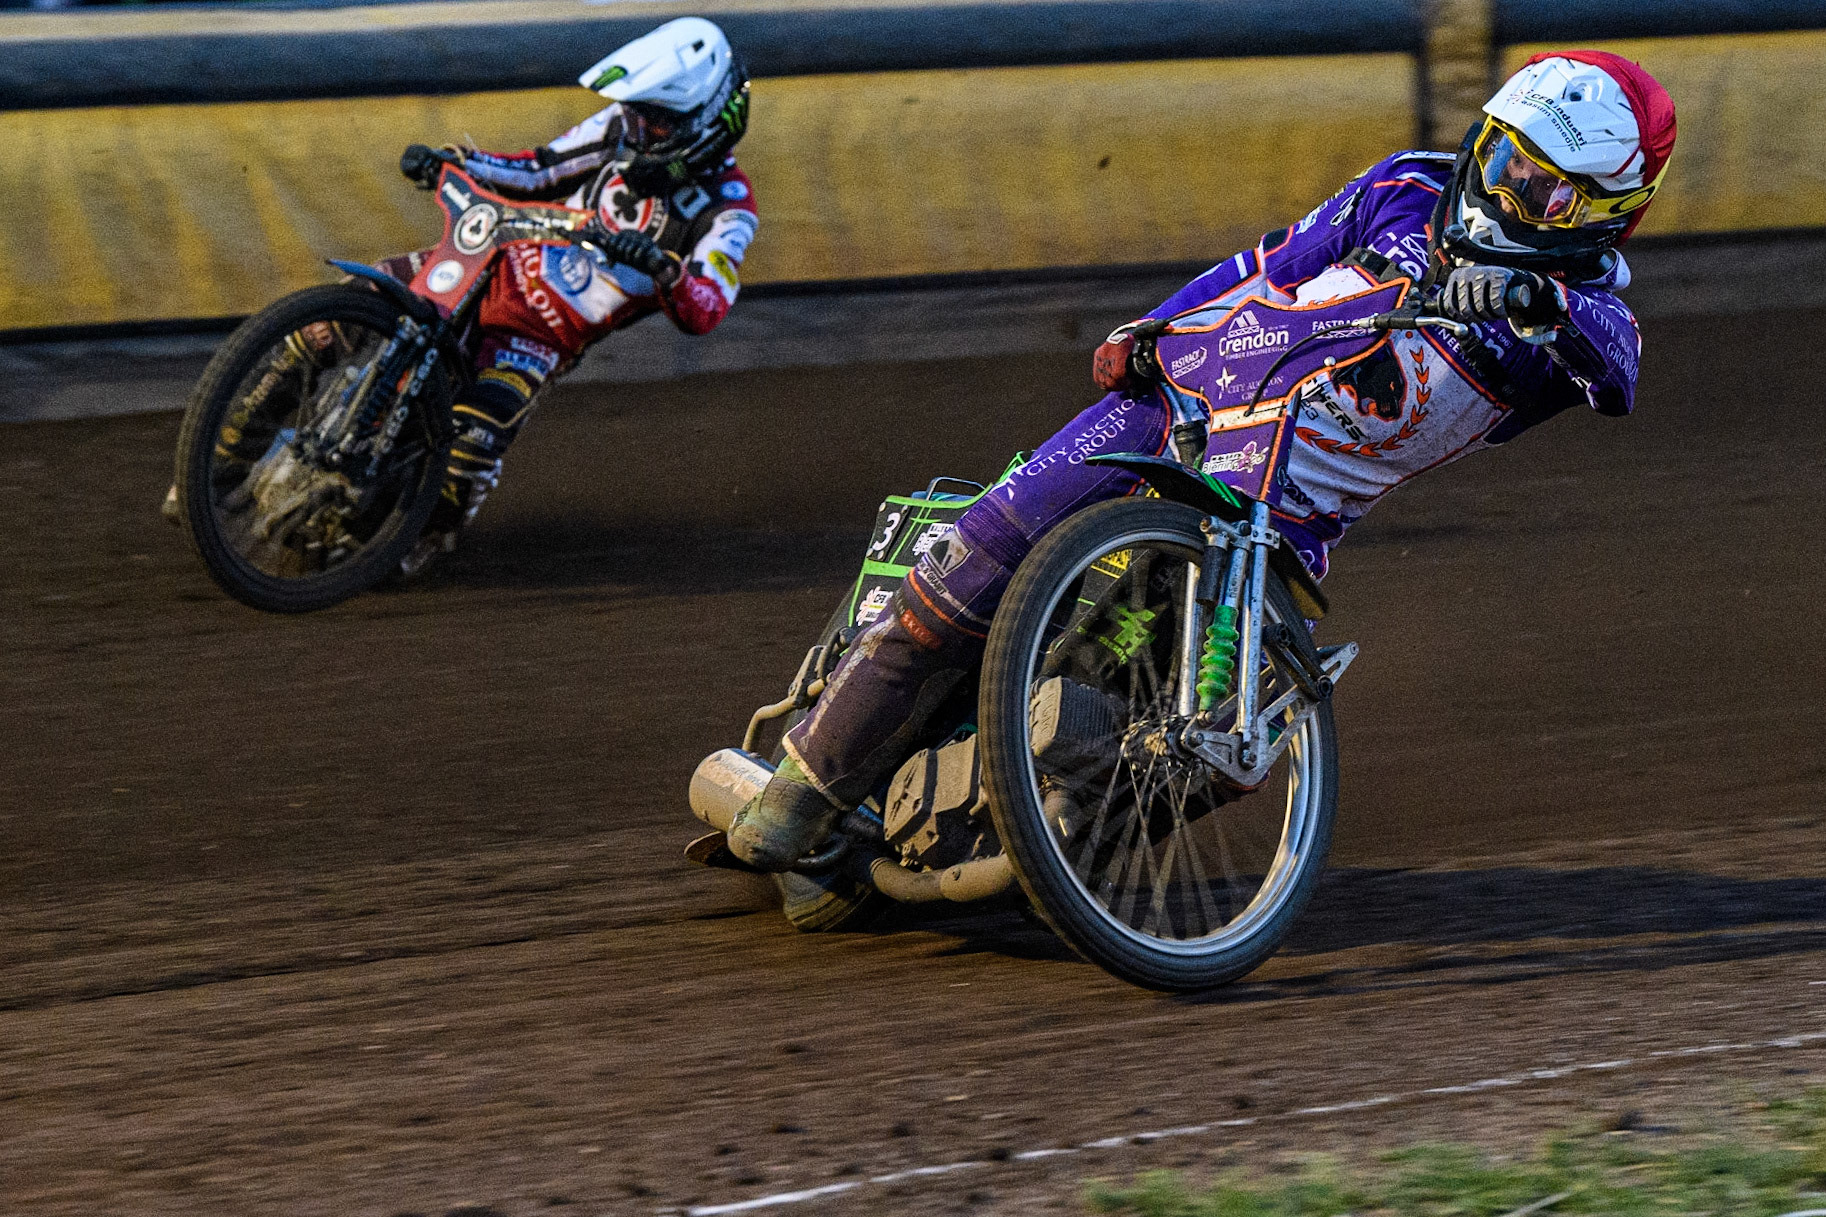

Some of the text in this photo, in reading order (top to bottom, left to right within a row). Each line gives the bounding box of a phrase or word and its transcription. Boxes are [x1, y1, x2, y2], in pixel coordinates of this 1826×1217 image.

[1553, 105, 1588, 147] industri
[1218, 327, 1290, 357] Crendon
[1593, 308, 1616, 338] CITY
[1026, 399, 1136, 477] CITY AUCTIO
[1067, 418, 1128, 466] GROUP
[872, 511, 902, 552] 3
